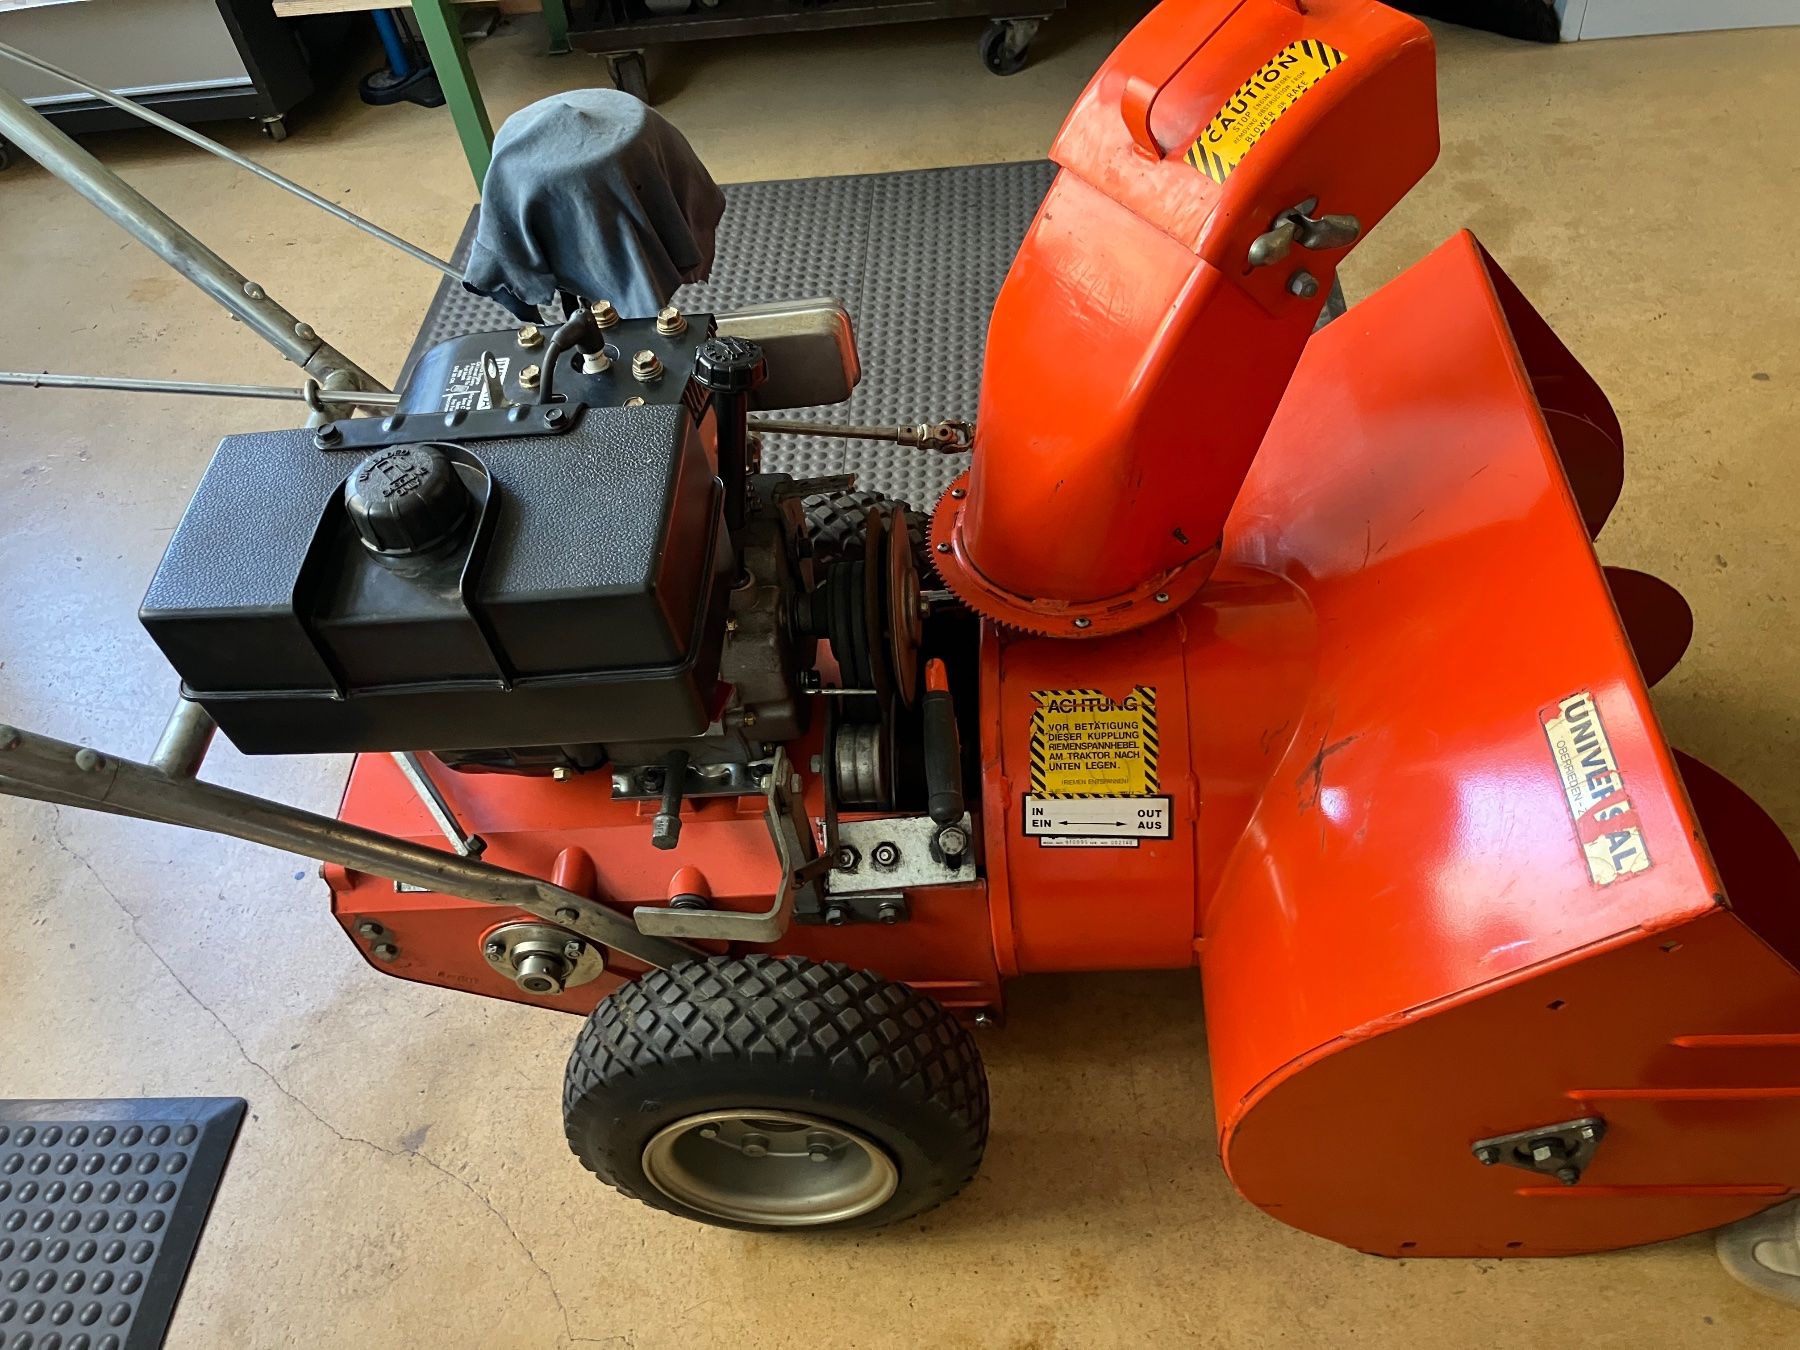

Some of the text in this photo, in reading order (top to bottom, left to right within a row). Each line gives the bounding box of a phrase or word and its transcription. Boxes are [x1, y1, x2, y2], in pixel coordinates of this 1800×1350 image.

[1208, 54, 1299, 143] CAUTION
[1232, 74, 1292, 133] STOP ENGINE BEFORE
[1234, 69, 1306, 145] REMOVING OBSTRUCTION FROM
[1244, 80, 1308, 143] BLOWER OR RAKE
[1048, 696, 1138, 714] ACHTUNG
[1048, 720, 1139, 732] VOR BETÄTIGUNG
[1048, 731, 1139, 741] DIESER KUPPLUNG
[1048, 741, 1139, 751] RIEMENSPANNHEBEL
[1049, 750, 1140, 761] AM TRAKTOR NACH
[1049, 761, 1120, 771] UNTEN LEGEN.
[1556, 740, 1582, 802] OBERRIEDEN
[1032, 808, 1162, 818] IN OUT
[1032, 819, 1162, 830] EIN AUS
